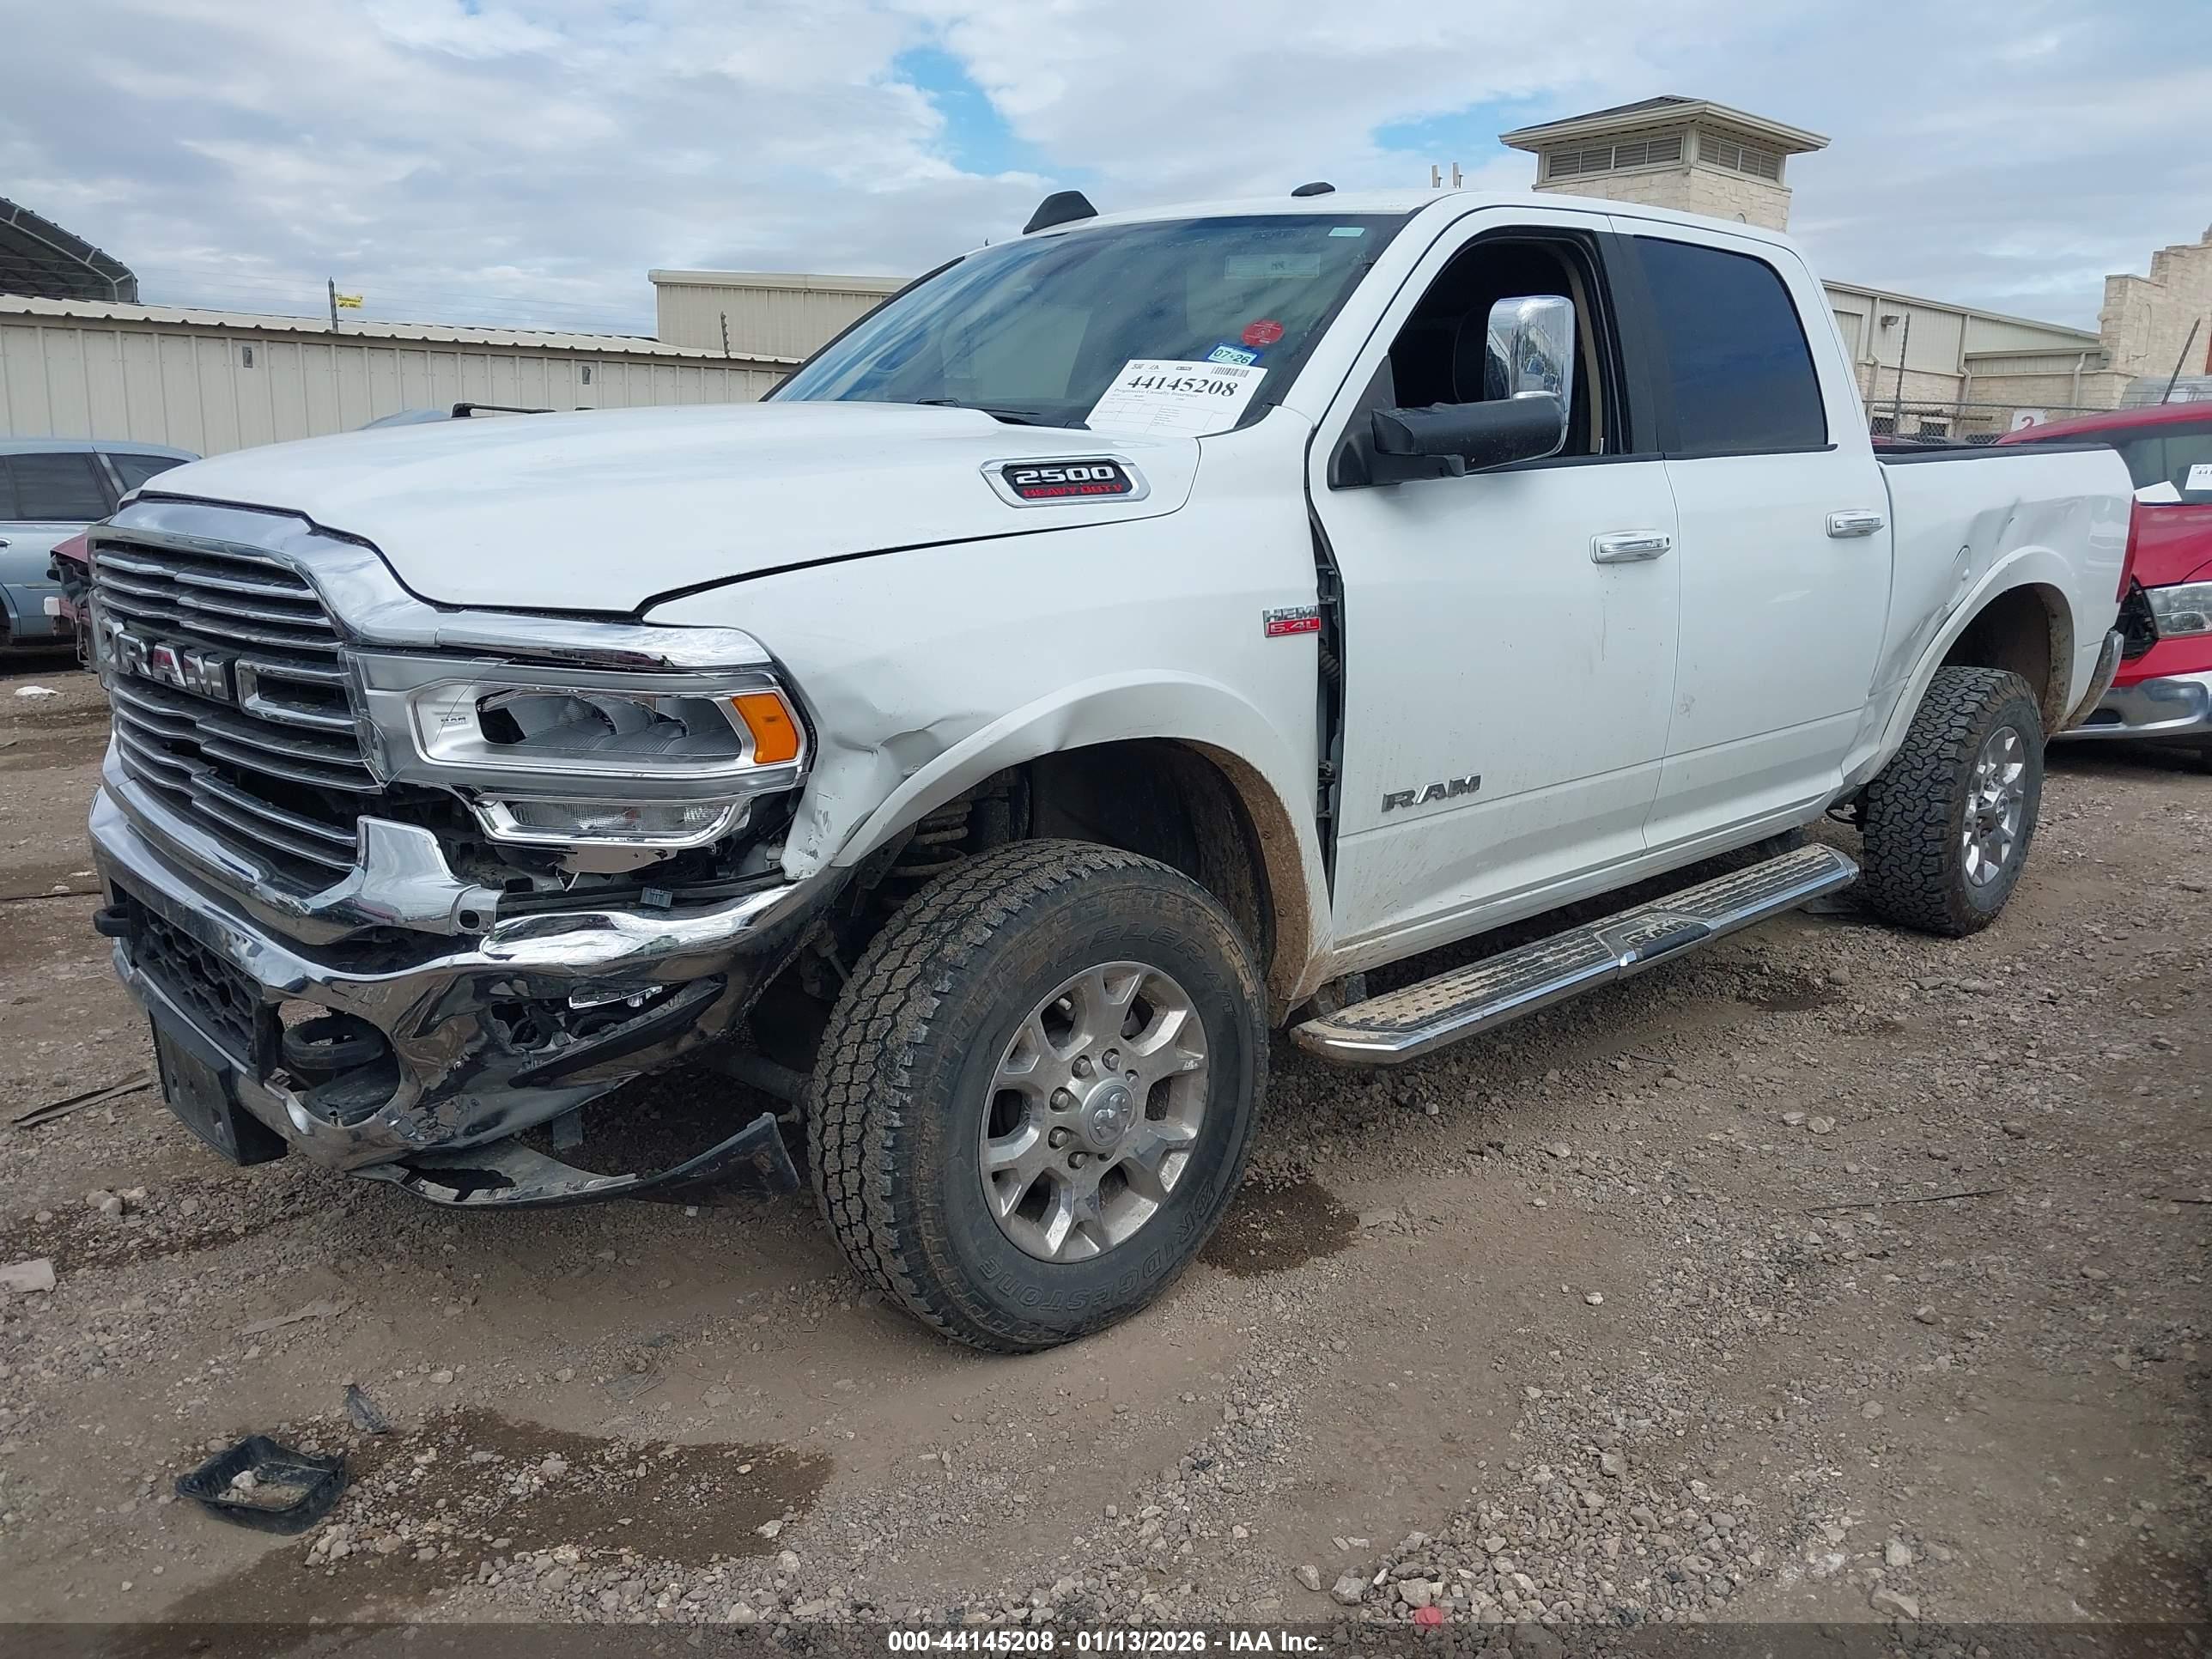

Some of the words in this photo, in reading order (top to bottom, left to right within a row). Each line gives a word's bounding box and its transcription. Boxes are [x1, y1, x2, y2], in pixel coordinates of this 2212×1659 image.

[1212, 349, 1231, 359] 07
[1231, 354, 1251, 364] 26
[1127, 374, 1239, 398] 44145208
[1014, 465, 1115, 484] 2500
[1023, 486, 1079, 498] HEAVY
[1080, 483, 1122, 495] DUTY
[1262, 605, 1319, 623] HEMI
[118, 632, 234, 701] RAM
[1381, 772, 1482, 813] RAM
[1620, 917, 1692, 946] RAM
[978, 1180, 1217, 1313] BRIDGESTONE
